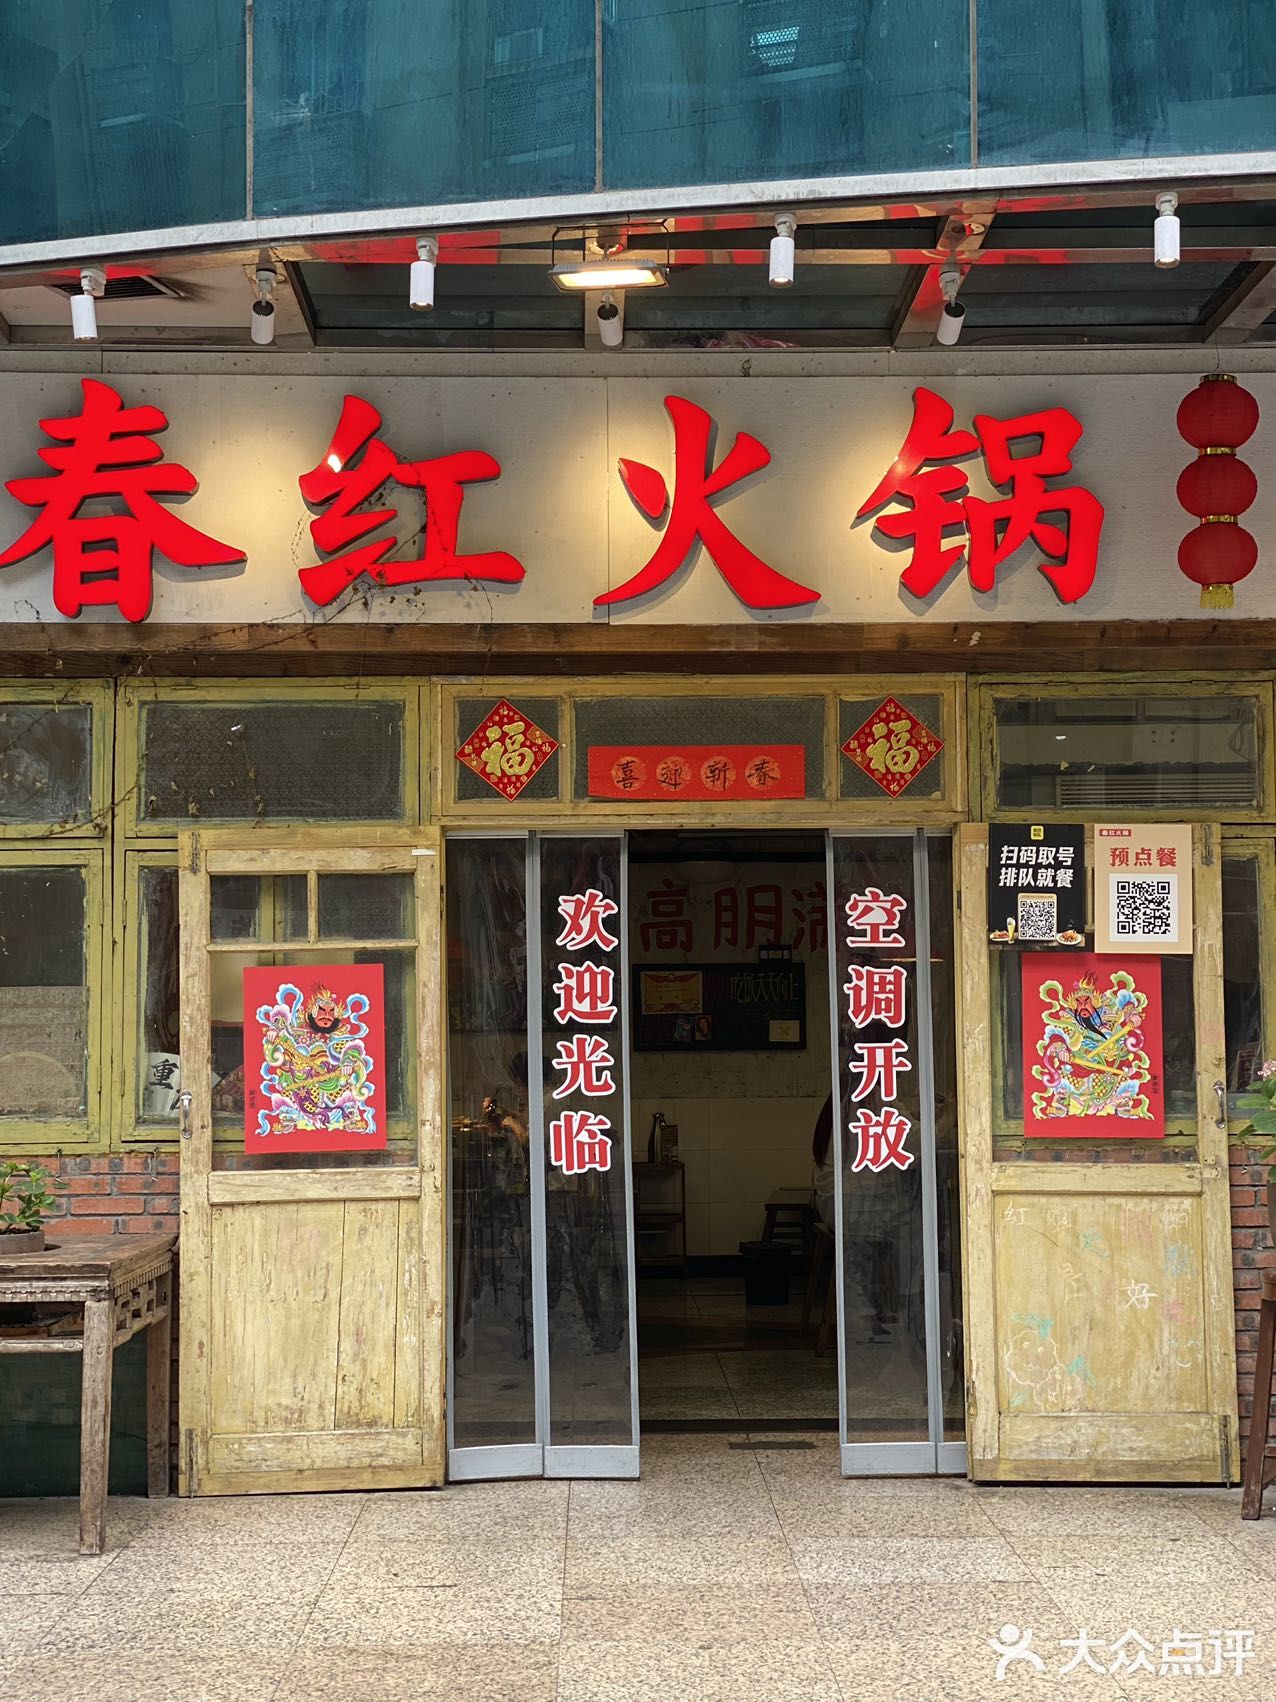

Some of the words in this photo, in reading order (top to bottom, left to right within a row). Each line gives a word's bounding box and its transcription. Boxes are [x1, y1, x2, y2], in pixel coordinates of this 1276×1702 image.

[0, 378, 1104, 623] 春红火锅
[481, 721, 535, 777] 福
[866, 719, 920, 774] 福
[615, 758, 778, 792] 喜迎新春
[999, 845, 1075, 866] 扫码取号
[1109, 847, 1177, 868] 预点餐
[998, 867, 1074, 888] 排队就餐
[549, 888, 619, 1175] 欢迎光临
[842, 886, 914, 1172] 空调开放
[149, 1058, 179, 1090] 重
[1118, 1279, 1159, 1310] 好
